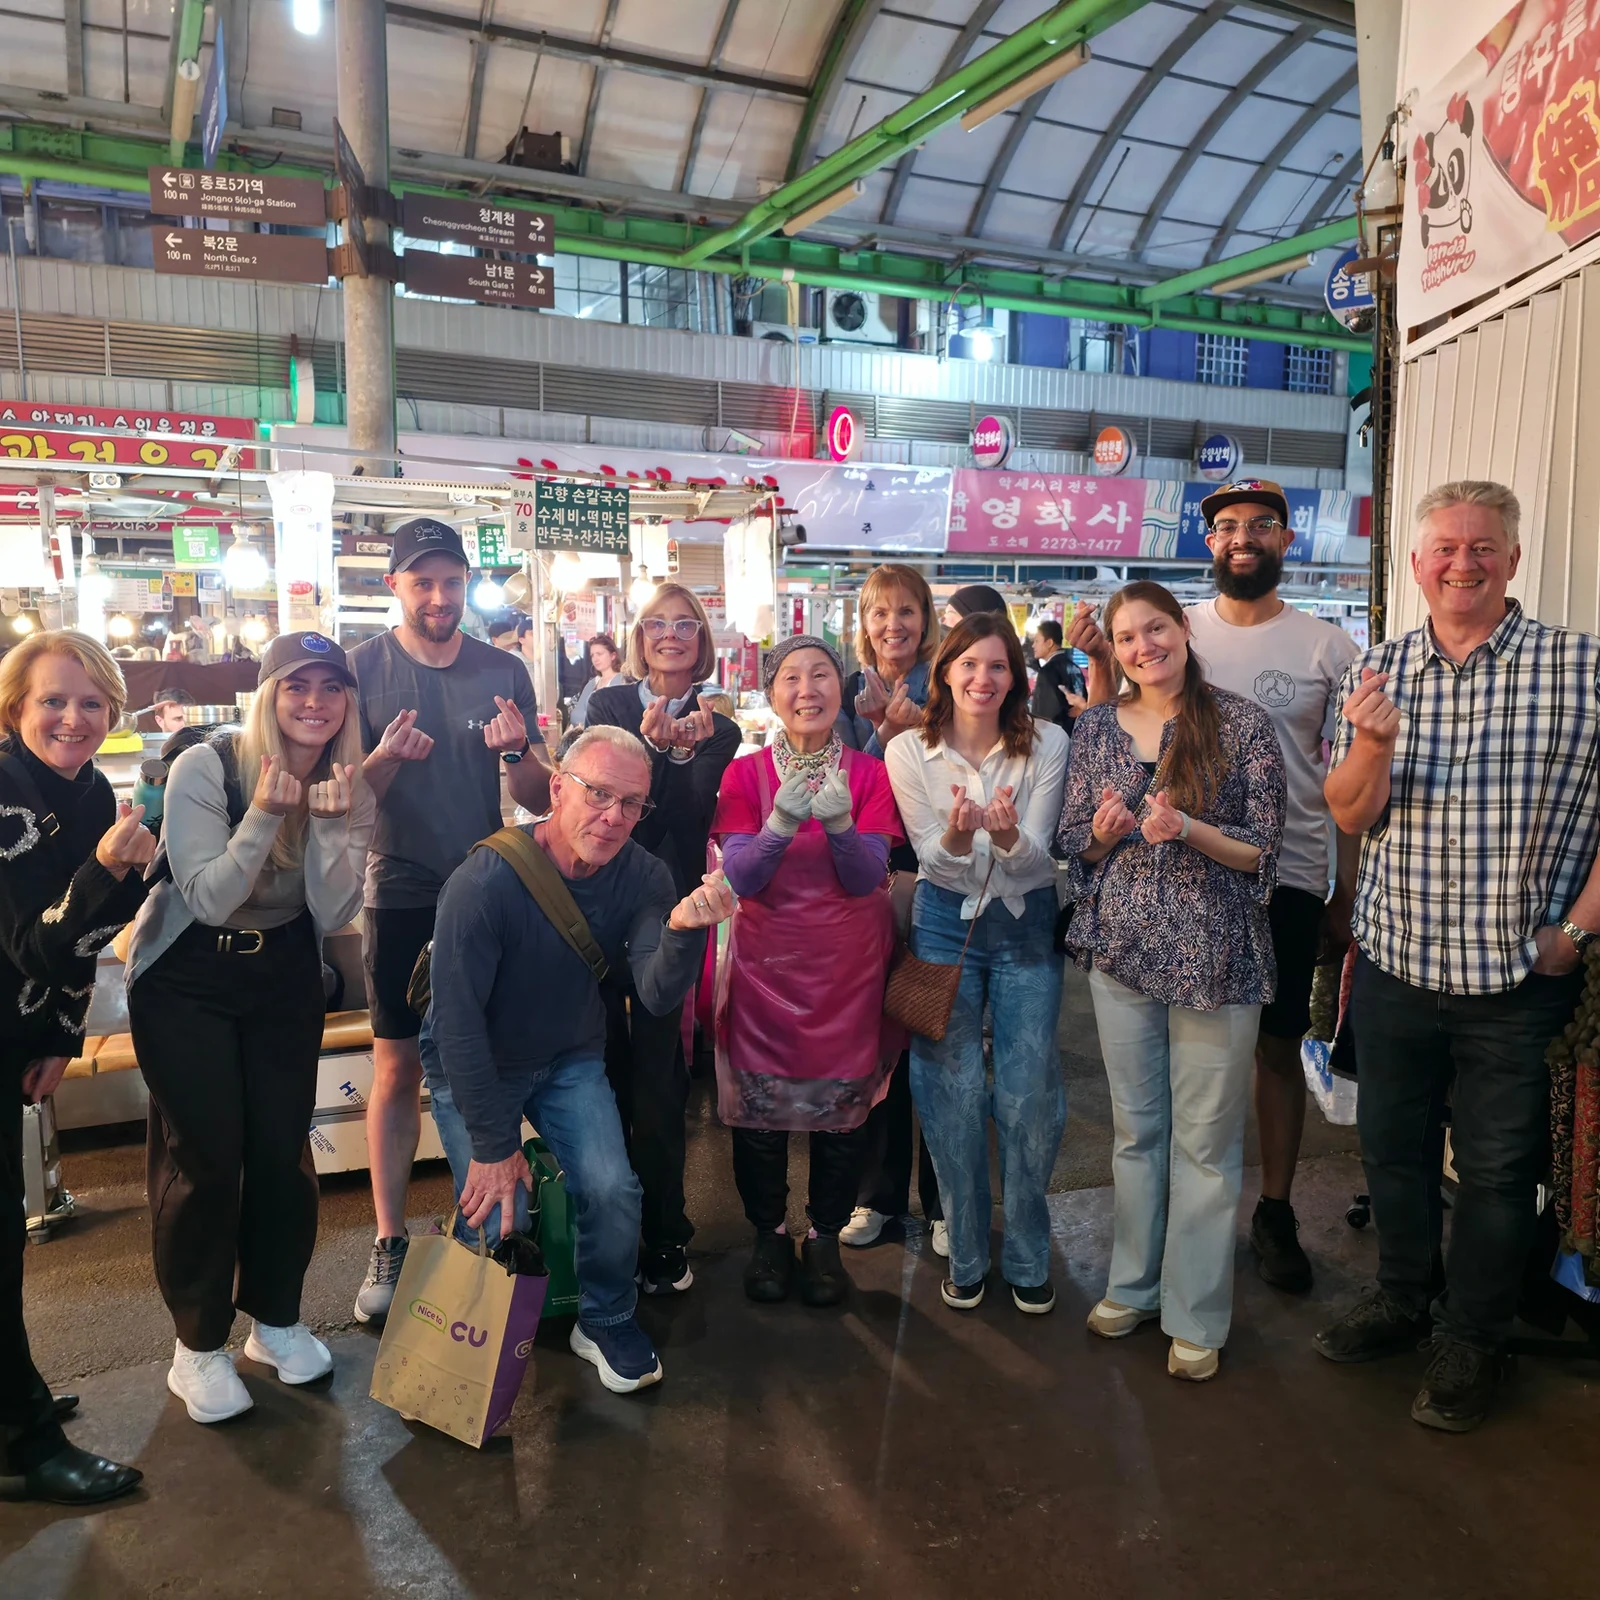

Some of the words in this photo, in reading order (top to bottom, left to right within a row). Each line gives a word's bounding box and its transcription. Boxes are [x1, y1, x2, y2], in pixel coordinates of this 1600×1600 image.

[200, 175, 264, 194] 종로5가역
[163, 189, 178, 200] 100
[179, 192, 189, 200] m
[200, 193, 233, 204] Jongno
[234, 196, 265, 207] 5(o)-ga
[266, 198, 297, 208] Station
[479, 208, 515, 227] 청계천
[422, 216, 487, 233] Cheonggyecheon
[488, 226, 515, 237] Stream
[203, 235, 238, 252] 북2문
[528, 232, 537, 241] 40
[166, 250, 181, 260] 100
[182, 253, 191, 261] m
[203, 253, 228, 262] North
[230, 255, 250, 264] Gate
[251, 256, 257, 264] 2
[485, 263, 515, 280] 남1문
[468, 277, 490, 289] South
[491, 281, 509, 289] Gate
[528, 285, 537, 294] 40
[537, 287, 546, 295] m
[998, 476, 1063, 493] 악세사리
[540, 485, 568, 502] 고향
[572, 487, 627, 507] 손칼국수
[514, 503, 533, 517] 70
[982, 496, 1132, 534] 영화사
[518, 521, 528, 533] 호
[1040, 537, 1123, 552] 2273-7477
[309, 1133, 325, 1152] STEEL
[314, 1128, 337, 1154] HYUNDAI
[417, 1304, 436, 1320] Nice
[435, 1315, 443, 1325] to
[451, 1321, 488, 1348] CU
